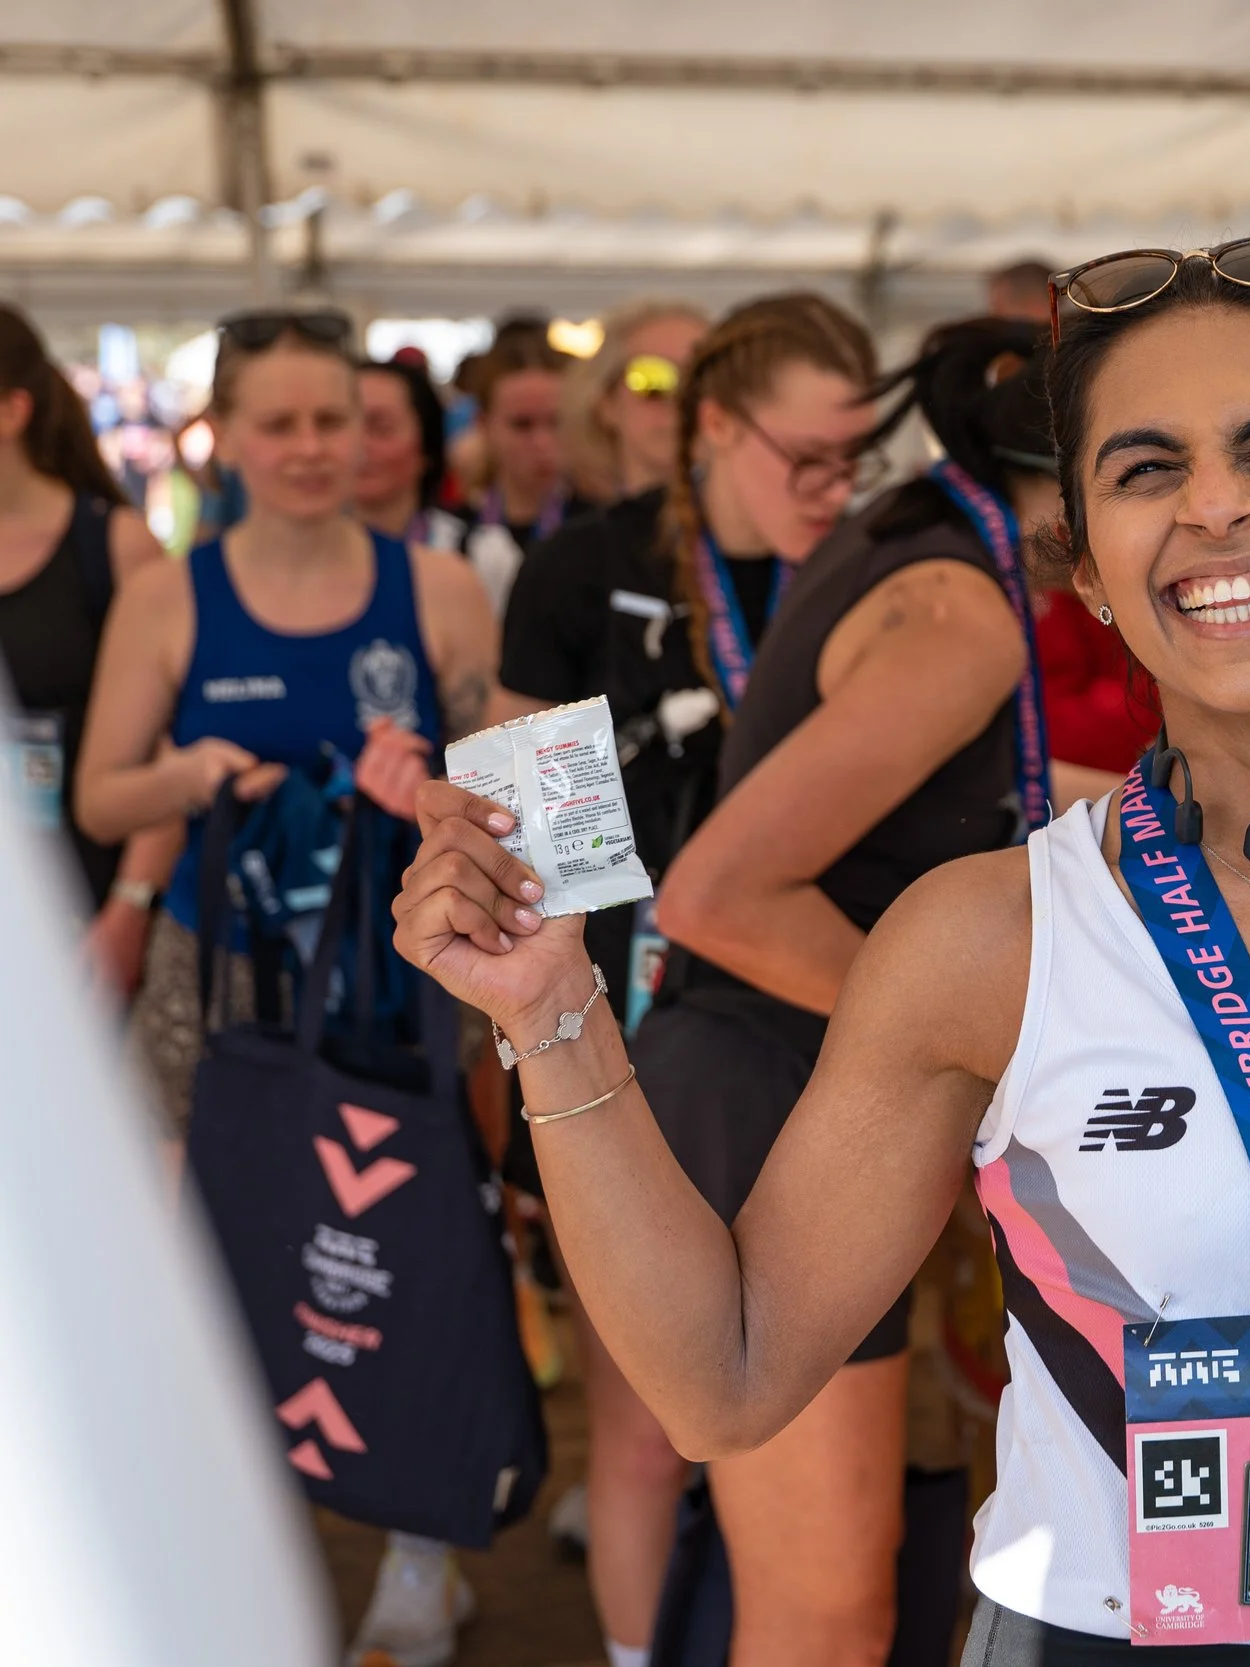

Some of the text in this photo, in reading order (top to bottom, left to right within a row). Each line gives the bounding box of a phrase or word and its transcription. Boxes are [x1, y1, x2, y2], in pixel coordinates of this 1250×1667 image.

[554, 843, 563, 855] 13
[1142, 850, 1210, 934] HALF
[1156, 1615, 1195, 1623] UNIVERSITY
[1155, 1621, 1204, 1630] CAMBRIDGE
